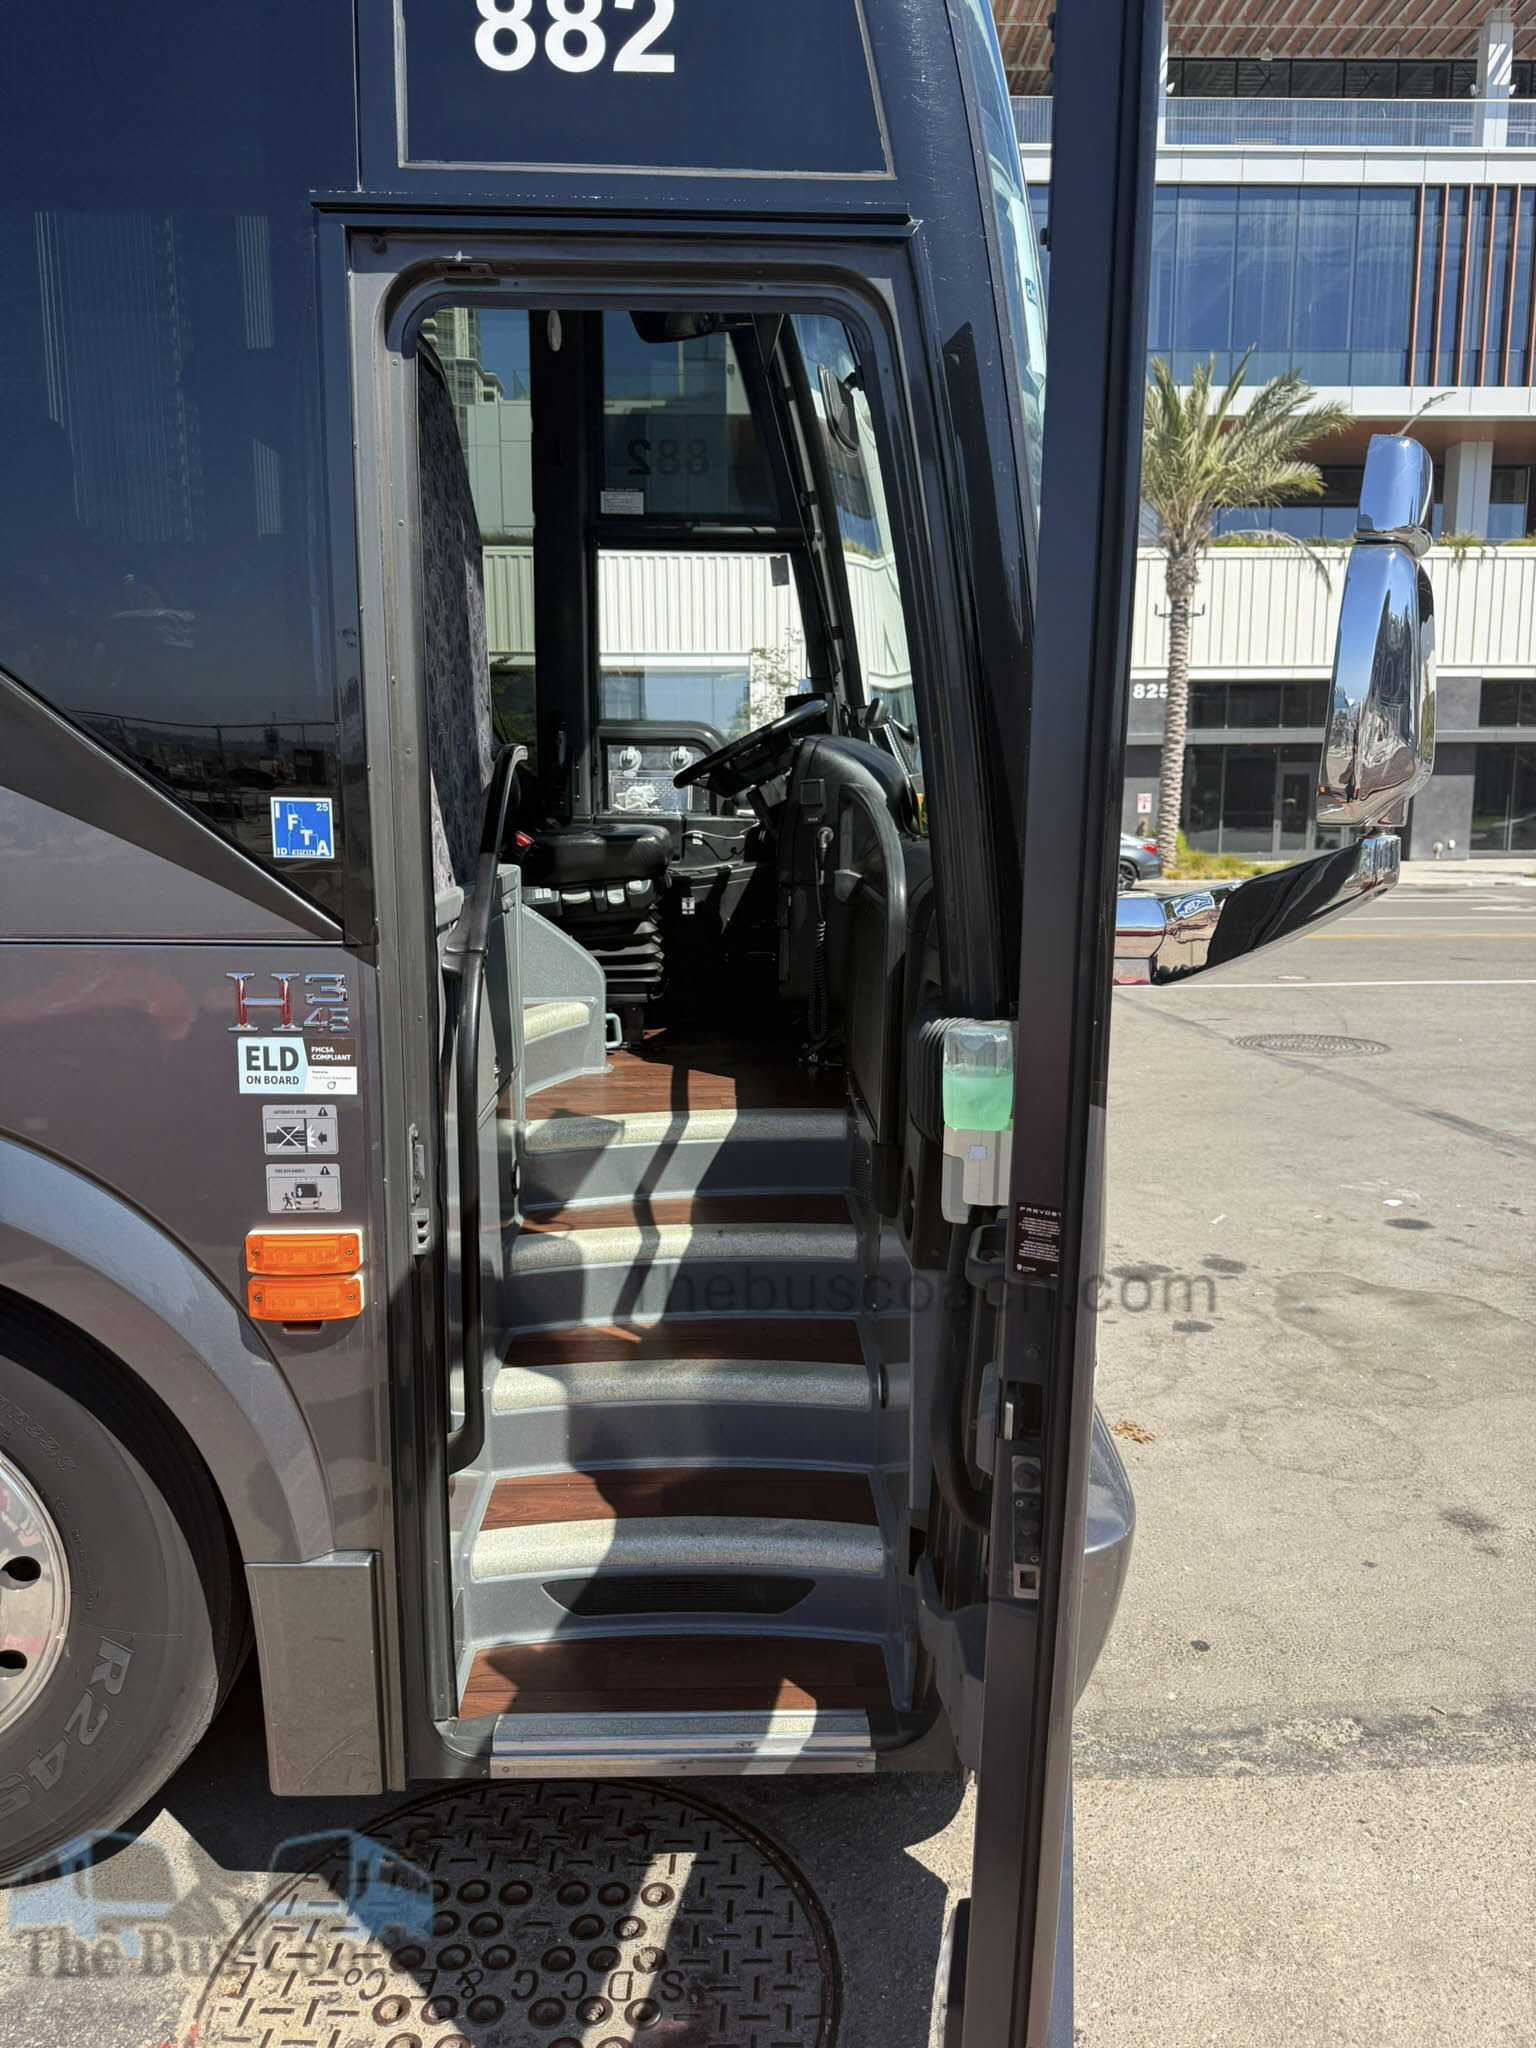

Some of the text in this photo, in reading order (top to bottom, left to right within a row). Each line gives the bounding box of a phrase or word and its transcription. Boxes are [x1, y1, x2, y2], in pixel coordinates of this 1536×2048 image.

[475, 0, 675, 73] 882
[316, 803, 328, 812] 25
[276, 847, 288, 856] ID
[311, 1046, 335, 1054] FMCSA
[245, 1045, 300, 1072] ELD
[246, 1075, 262, 1085] ON
[264, 1075, 300, 1085] BOARD
